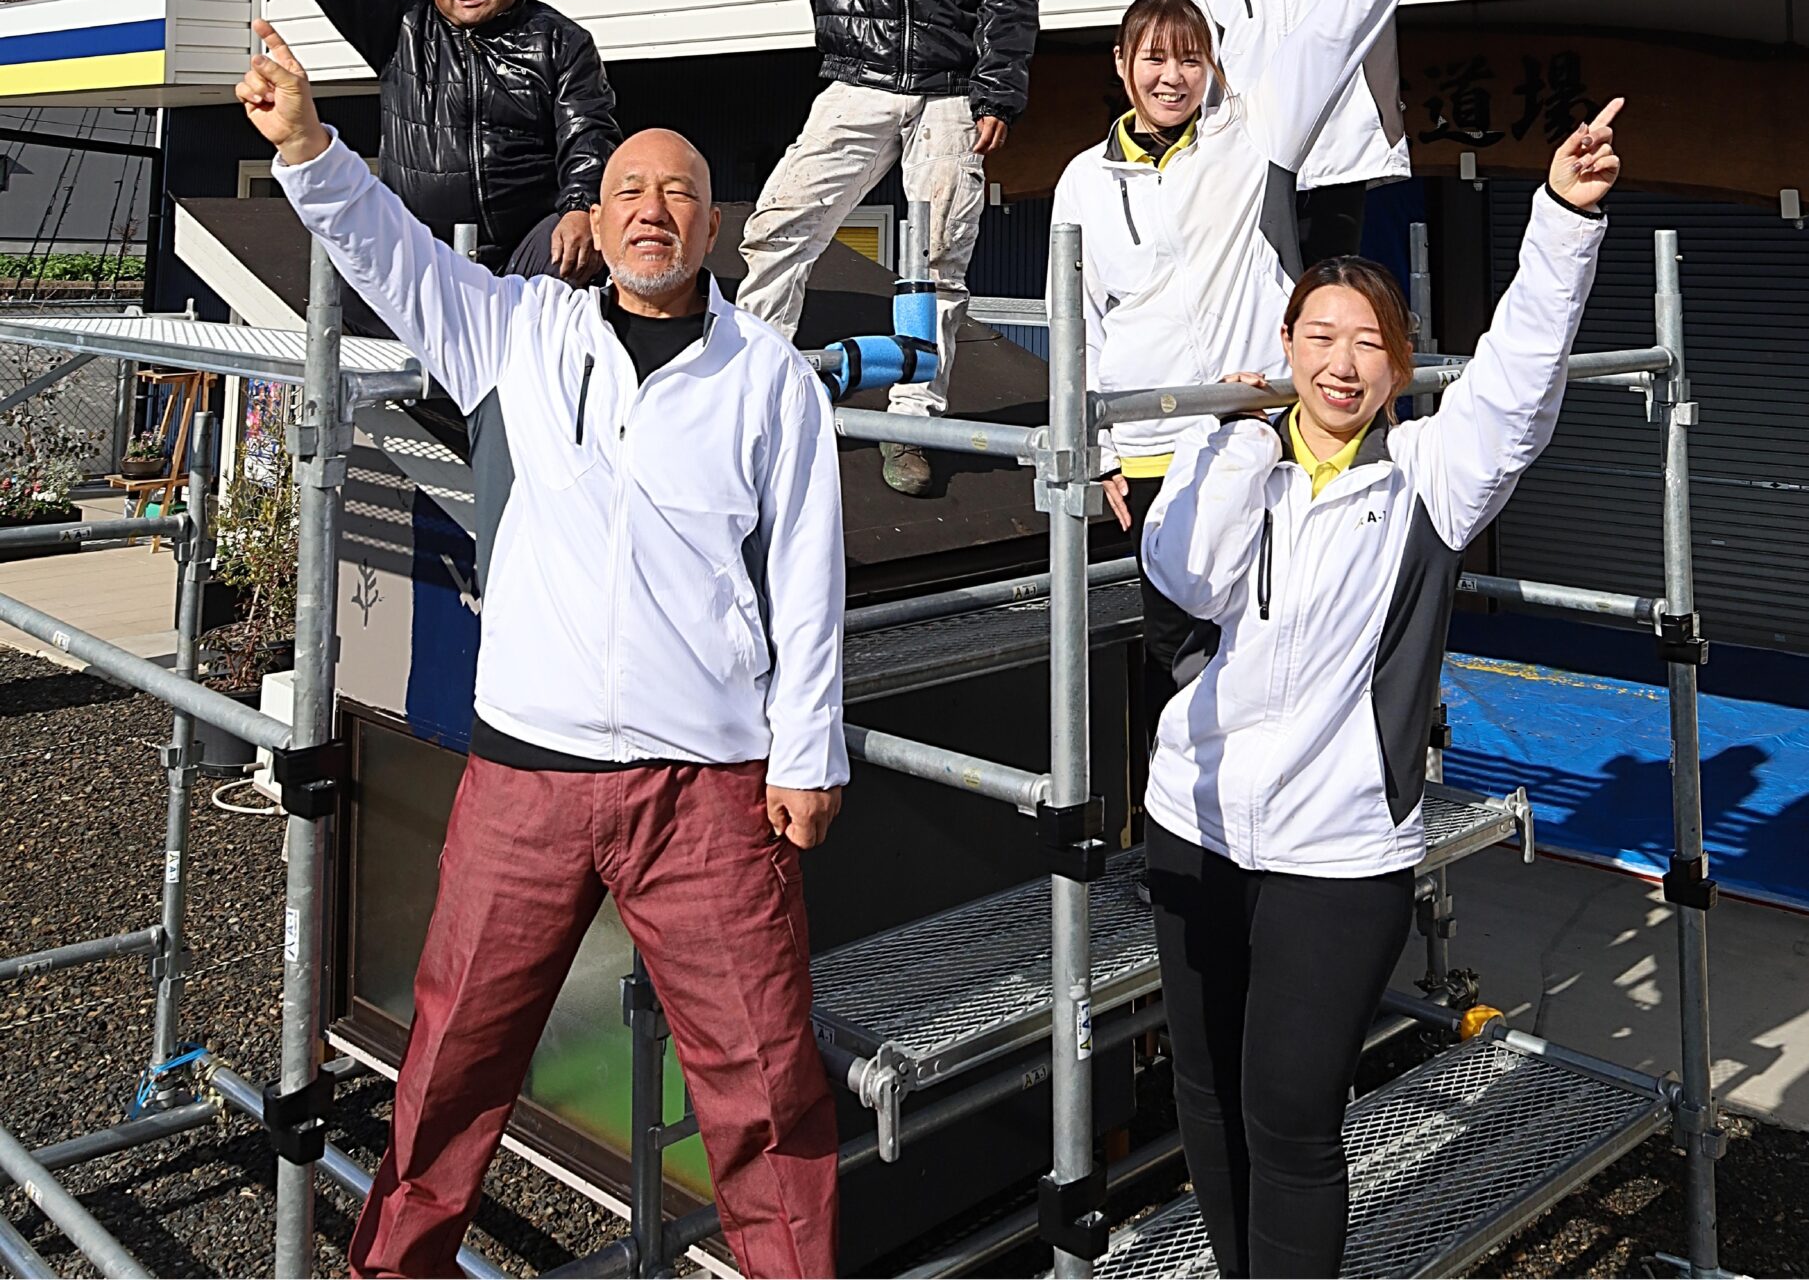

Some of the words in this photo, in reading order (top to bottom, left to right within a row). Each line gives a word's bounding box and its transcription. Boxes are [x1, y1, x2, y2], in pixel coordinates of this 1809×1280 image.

[1367, 510, 1387, 523] A-1
[1082, 1002, 1090, 1029] A-1
[817, 1028, 833, 1044] A-1
